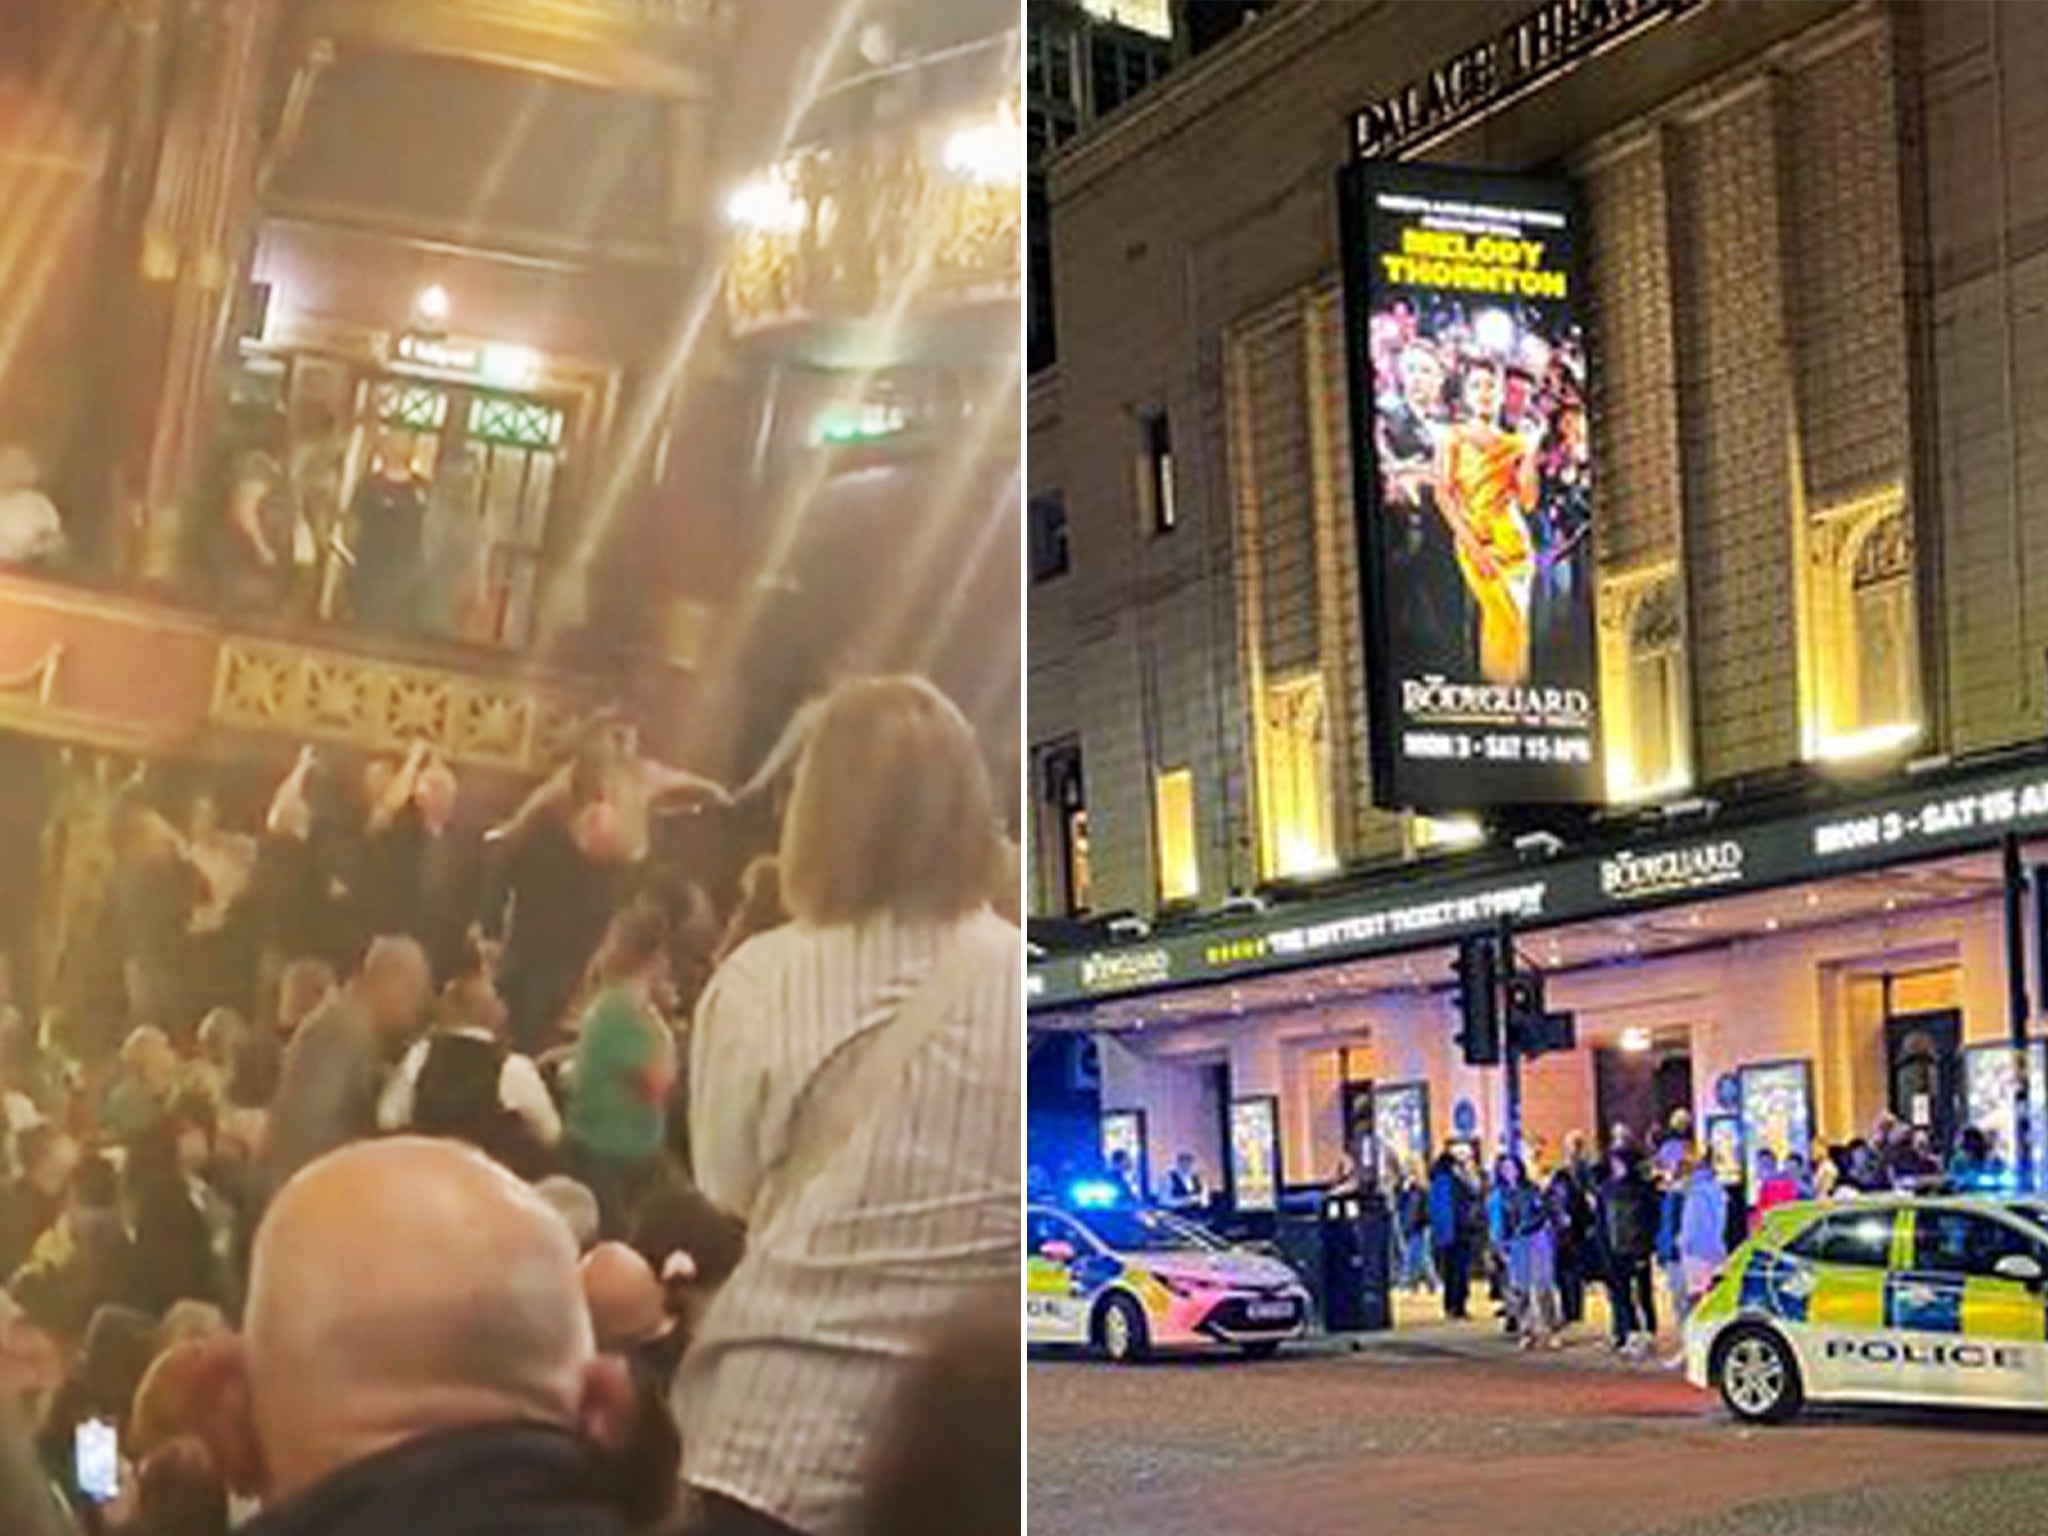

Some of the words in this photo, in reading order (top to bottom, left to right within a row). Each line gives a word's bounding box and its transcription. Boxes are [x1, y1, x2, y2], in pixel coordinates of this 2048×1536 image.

[1353, 44, 1497, 158] PALACE
[1403, 229, 1545, 267] MELODY
[1381, 255, 1566, 298] THORNTON
[1402, 680, 1588, 717] BODYGUARD
[1815, 816, 1880, 855] MON
[1882, 812, 1902, 842] 3
[1922, 795, 1976, 835] SAT
[1601, 841, 1744, 892] BODYGUARD
[1826, 1340, 2023, 1368] POLICE
